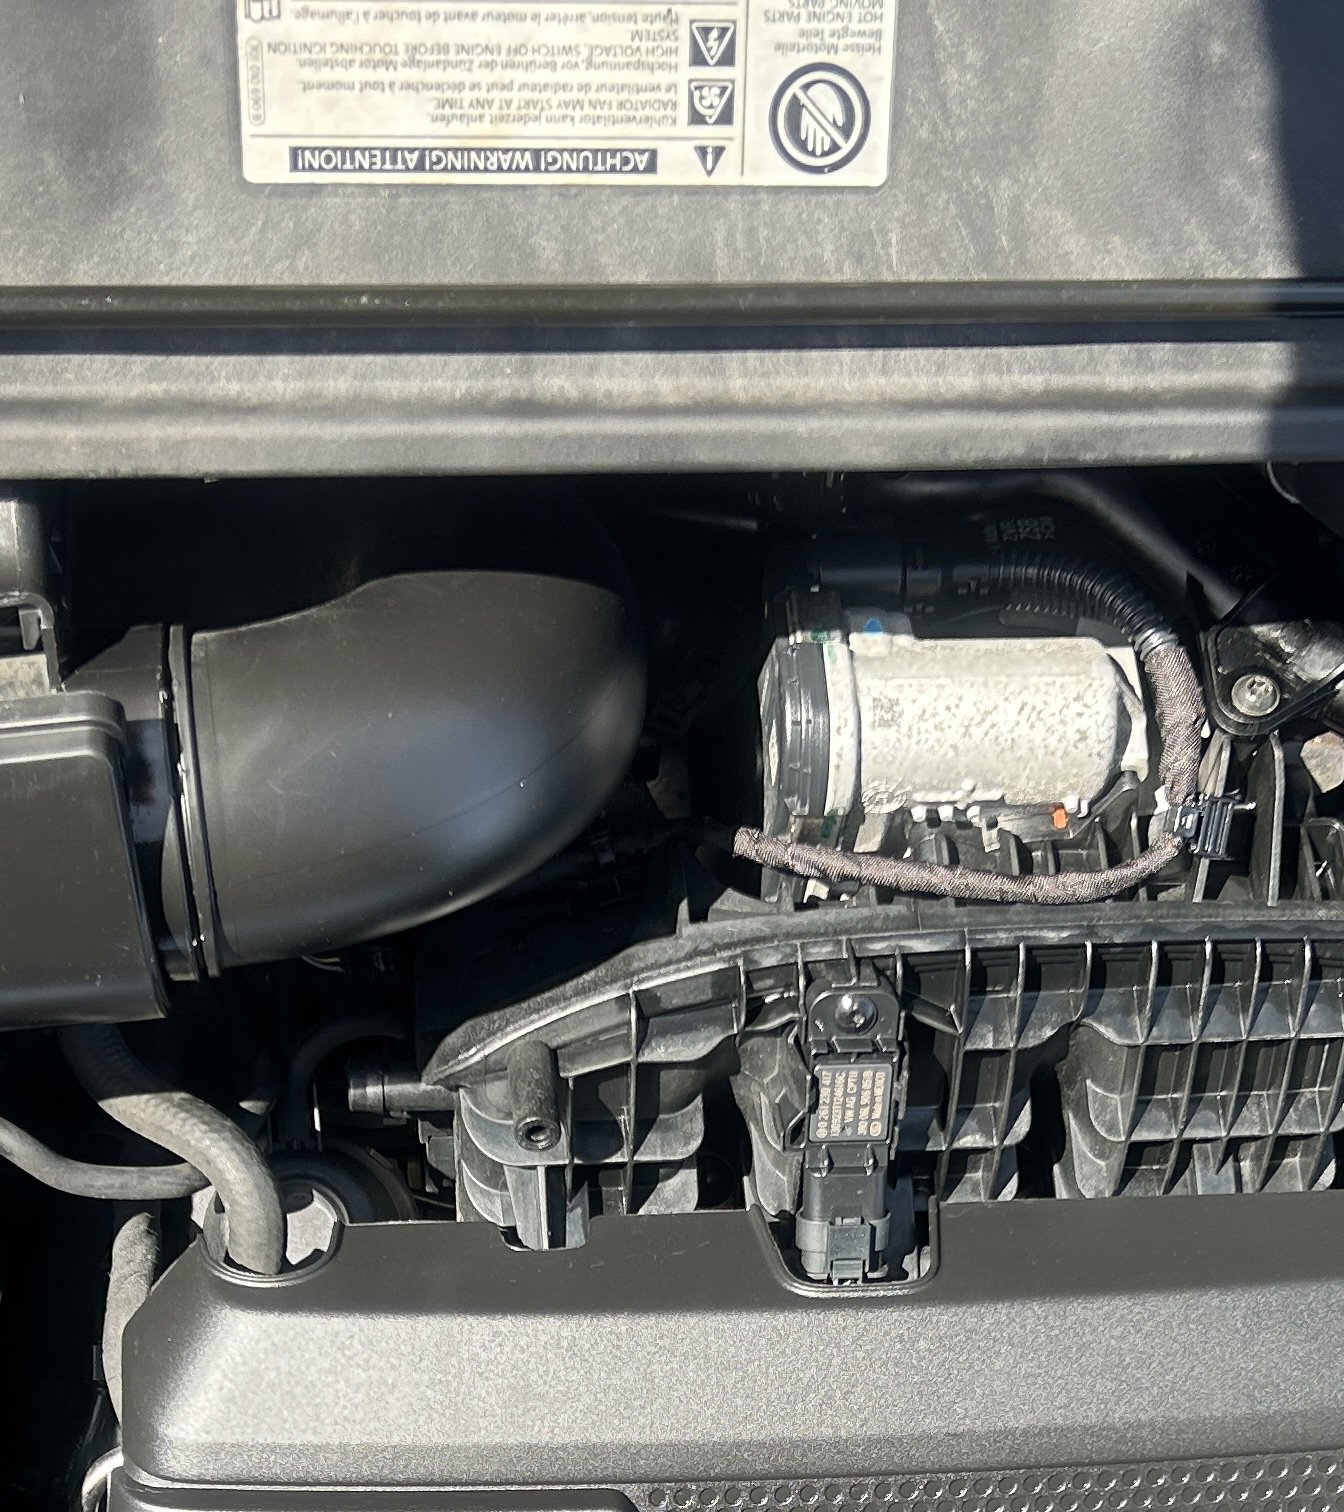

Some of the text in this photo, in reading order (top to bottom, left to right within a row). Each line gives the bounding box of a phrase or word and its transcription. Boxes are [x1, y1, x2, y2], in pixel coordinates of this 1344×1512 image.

[788, 0, 825, 9] PARTS
[374, 10, 421, 24] toucher
[425, 11, 440, 24] de
[444, 10, 479, 23] avant
[482, 11, 528, 23] moteur
[531, 12, 541, 25] le
[763, 9, 884, 23] HOT ENGINE PARTS
[798, 26, 883, 41] Bewegte Teile
[267, 42, 327, 55] IGNITION
[330, 42, 398, 55] TOUCHING
[404, 42, 450, 56] BEFORE
[454, 43, 501, 56] ENGINE
[505, 44, 528, 57] OFF
[532, 44, 580, 57] SWITCH
[645, 45, 678, 57] HIGH
[774, 42, 882, 56] Heisse Motorteile
[358, 58, 398, 71] Motor
[400, 55, 475, 72] Zündanlage
[478, 59, 497, 73] der
[501, 60, 557, 73] Berühren
[562, 60, 579, 70] vor
[359, 81, 385, 94] tout
[399, 81, 466, 96] déclencher
[469, 82, 482, 92] se
[486, 79, 514, 94] peut
[517, 82, 573, 95] radiateur
[576, 82, 592, 95] de
[595, 82, 662, 95] ventilateur
[664, 82, 678, 95] Le
[468, 98, 494, 111] ANY
[498, 98, 513, 111] AT
[517, 98, 552, 111] START
[557, 98, 584, 111] MAY
[588, 98, 612, 111] FAN
[616, 98, 678, 111] RADIATOR
[489, 109, 543, 128] jederzeit
[546, 114, 575, 128] kann
[579, 113, 678, 128] Kühlerventilator
[297, 148, 649, 172] ACHTUNG! WARNING! ATTENTION!
